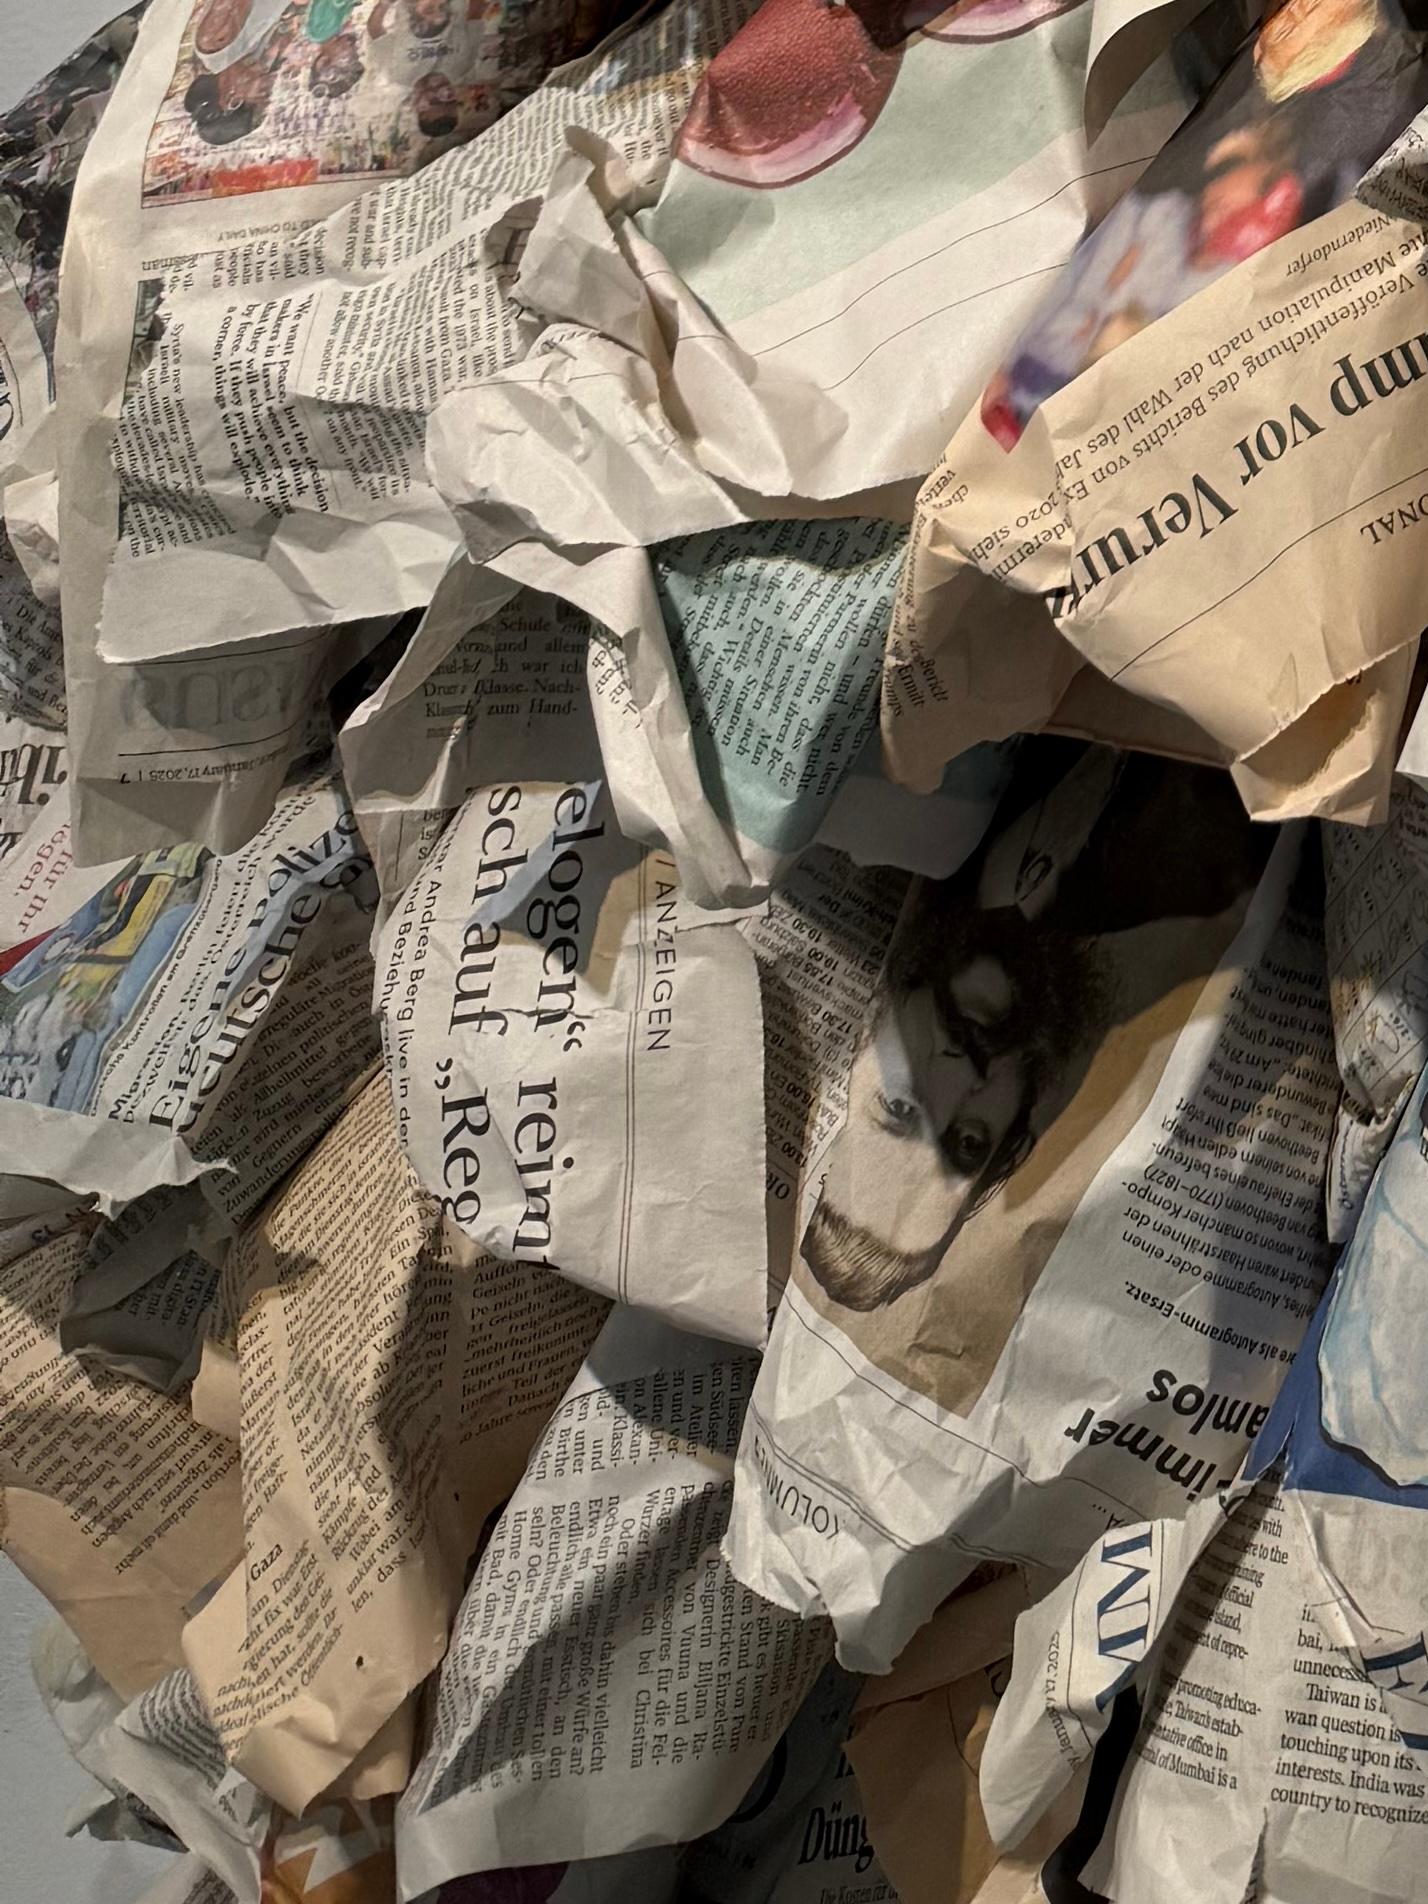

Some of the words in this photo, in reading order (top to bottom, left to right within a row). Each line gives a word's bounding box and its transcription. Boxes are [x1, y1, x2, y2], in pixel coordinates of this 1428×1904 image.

[1258, 250, 1396, 331] Manipulation
[1207, 327, 1254, 366] nach
[1241, 273, 1414, 377] Veröffentlichung
[1174, 362, 1203, 392] der
[1207, 371, 1240, 401] des
[1086, 424, 1120, 454] des
[1122, 388, 1173, 433] Wahl
[1132, 395, 1206, 457] Berichts
[1090, 454, 1130, 483] von
[1233, 403, 1324, 485] vor
[299, 456, 329, 515] decision
[471, 780, 528, 904] sch
[409, 880, 441, 961] Andrea
[394, 967, 425, 1021] Berg
[448, 922, 508, 1035] auf
[647, 881, 680, 1050] ANZEIGEN
[1121, 1229, 1164, 1259] einen
[1125, 1281, 1258, 1353] Autogramm-Ersatz.
[1064, 1408, 1216, 1501] immer
[692, 1558, 722, 1648] Designerin
[1305, 1682, 1360, 1709] Taiwan
[589, 1692, 610, 1773] vielleicht
[630, 1689, 651, 1768] Christina
[1278, 1733, 1349, 1763] touching
[1315, 1715, 1385, 1741] question
[1270, 1787, 1332, 1813] country
[1274, 1757, 1345, 1785] interests.
